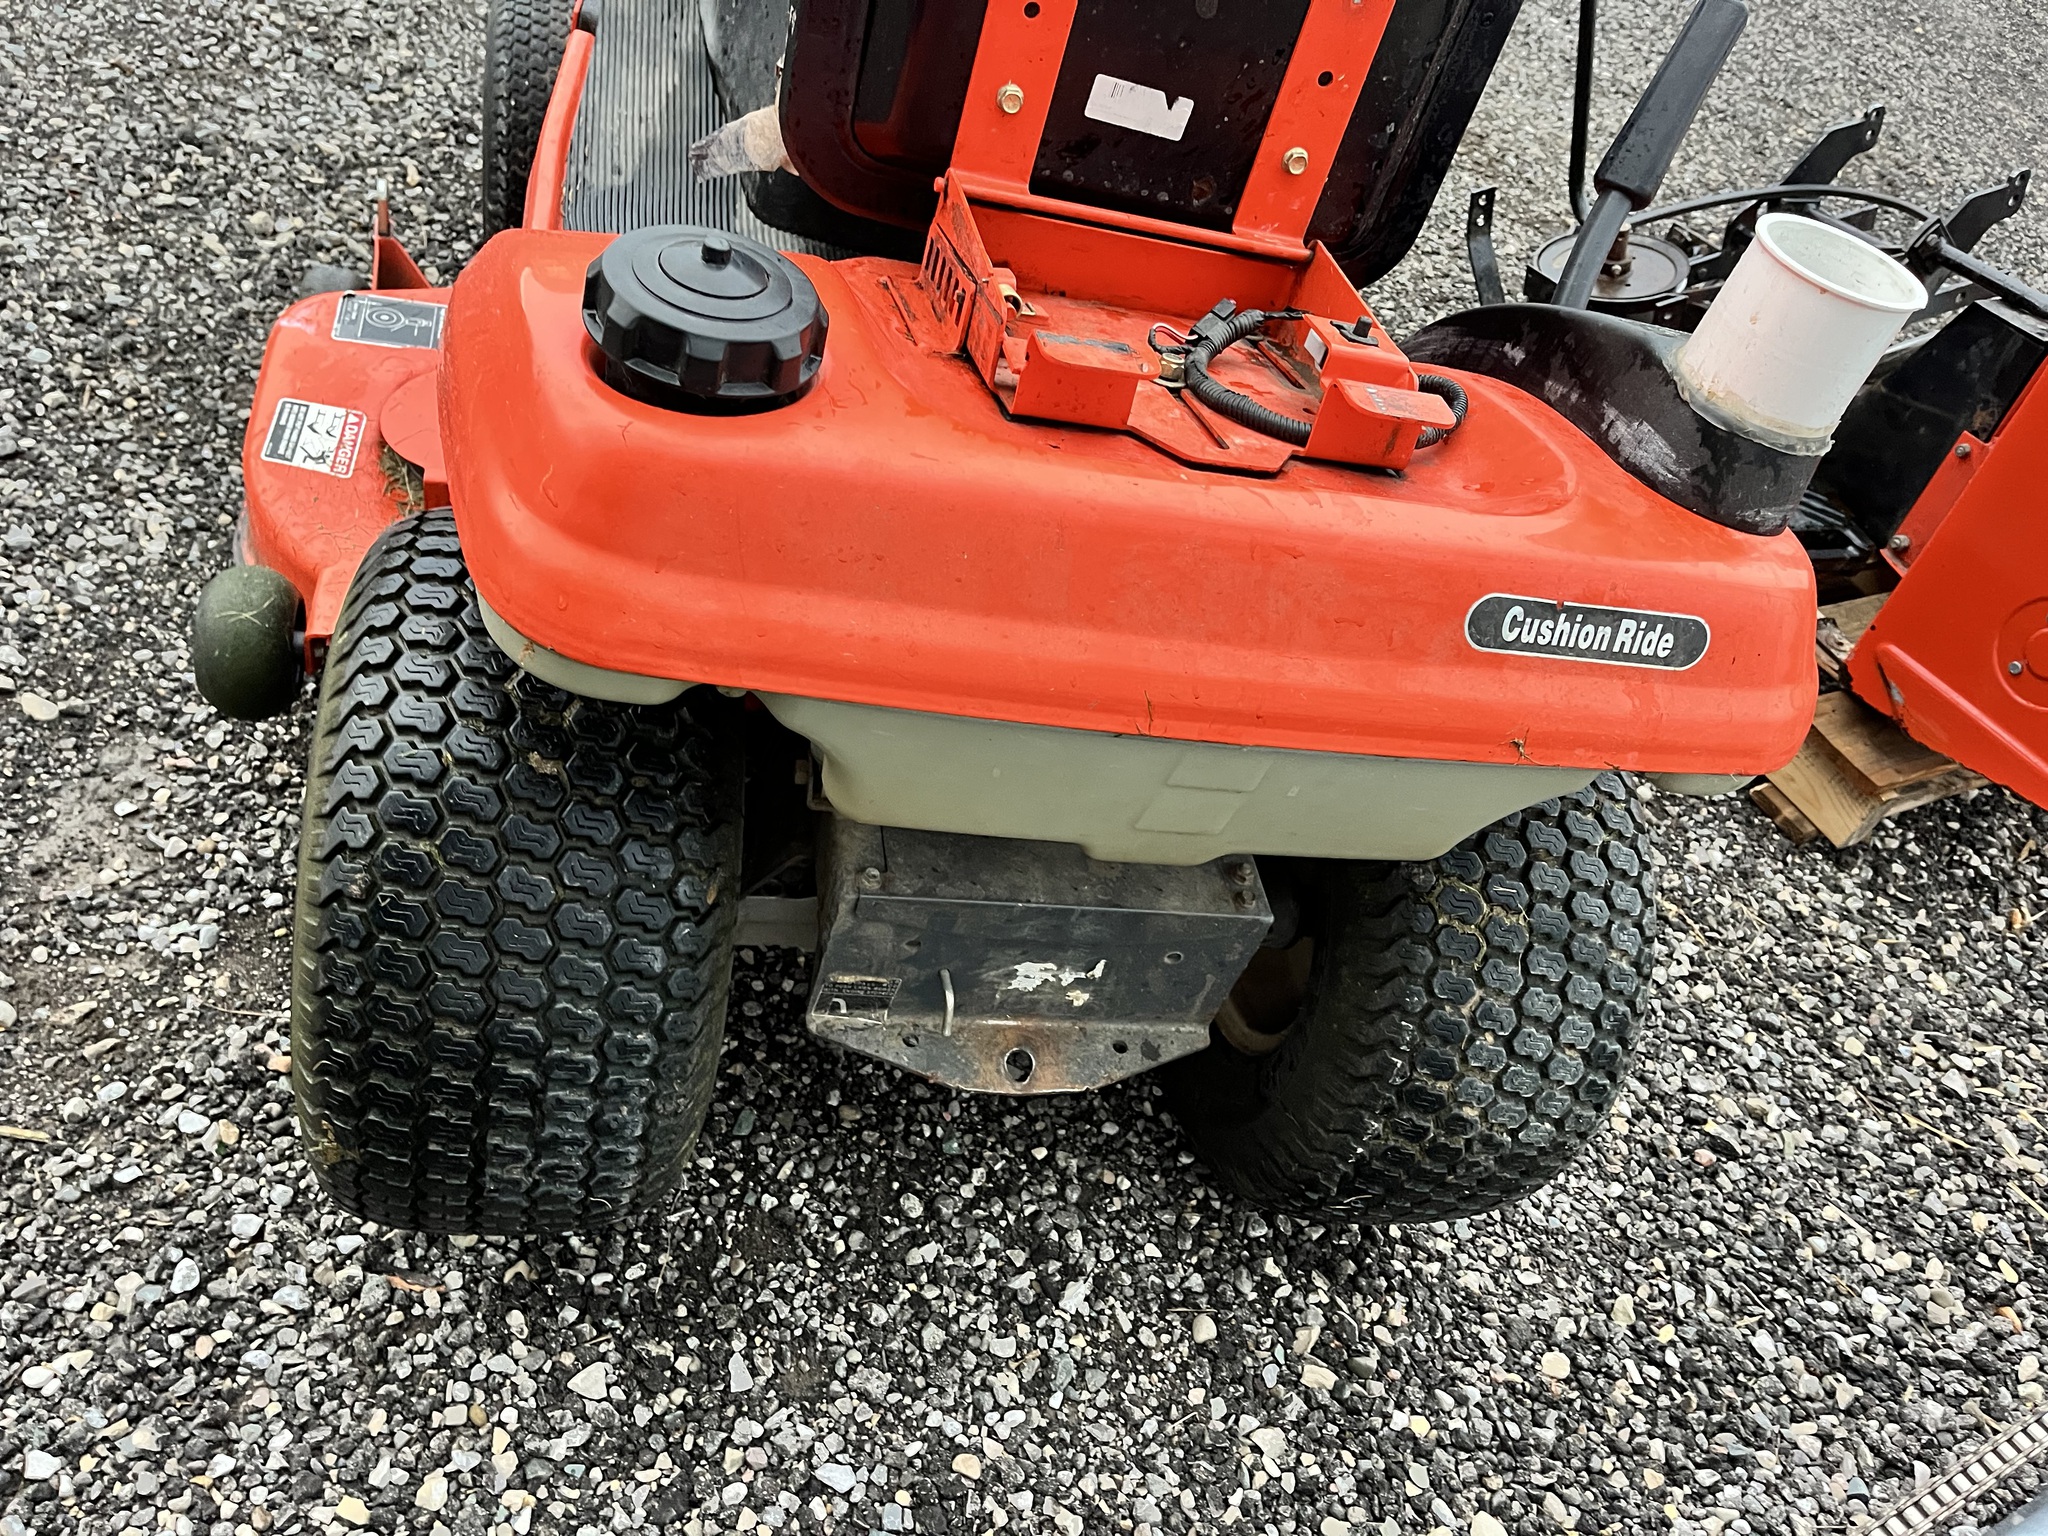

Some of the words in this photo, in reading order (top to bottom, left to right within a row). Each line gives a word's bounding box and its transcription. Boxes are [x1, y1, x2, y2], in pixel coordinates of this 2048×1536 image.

[333, 425, 358, 473] DANGER
[1501, 605, 1612, 652] Cushion
[1612, 618, 1675, 658] Ride
